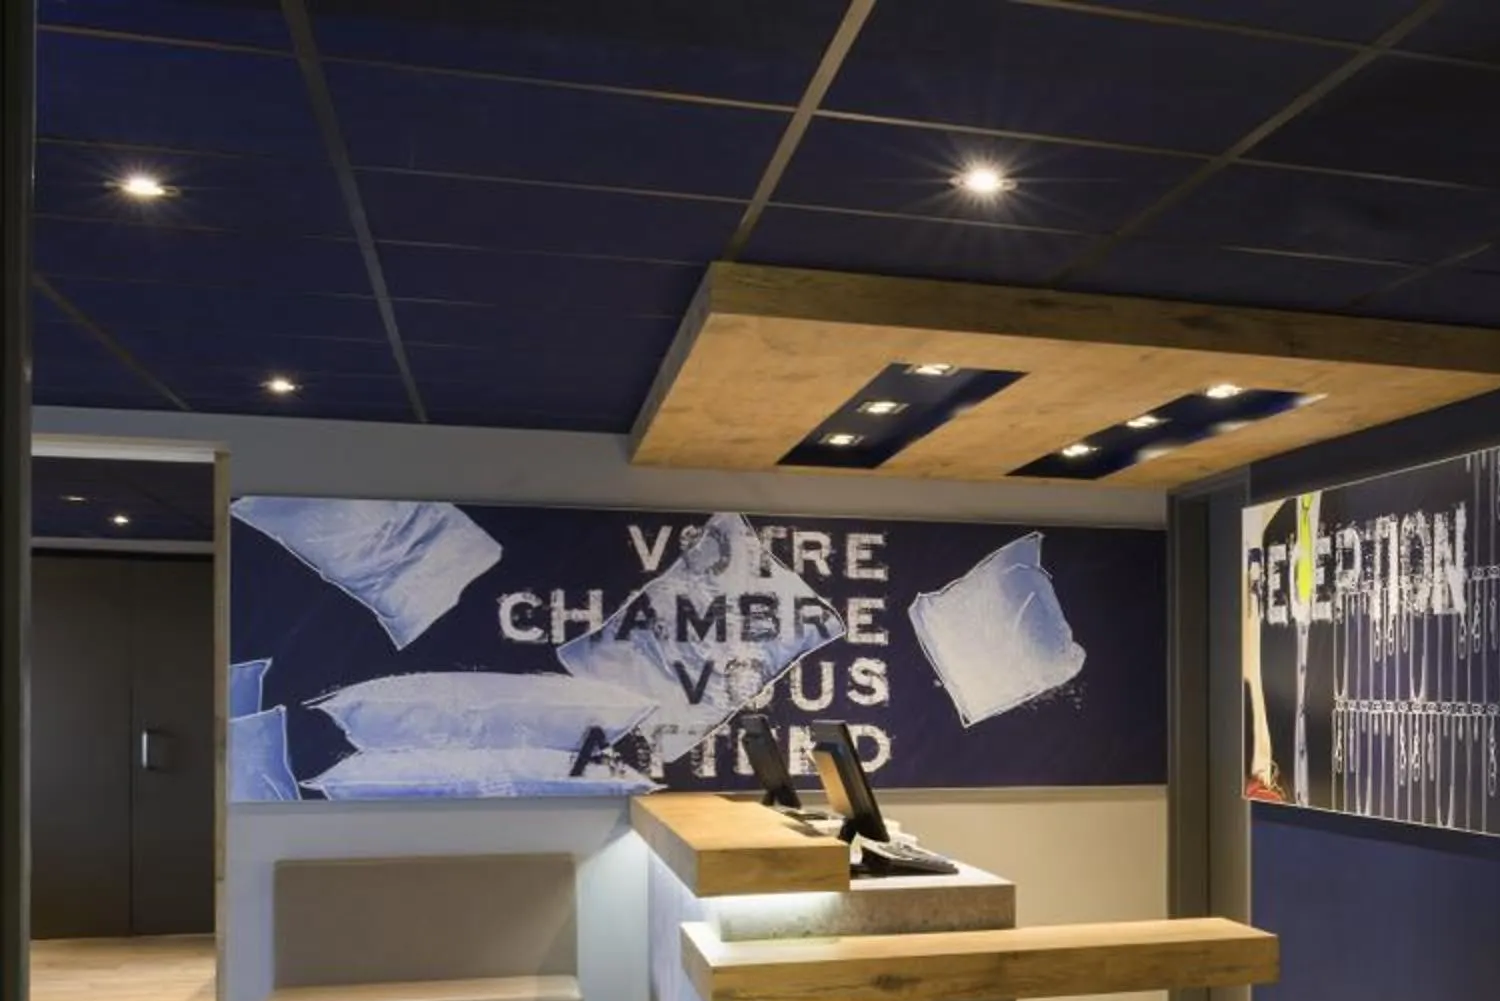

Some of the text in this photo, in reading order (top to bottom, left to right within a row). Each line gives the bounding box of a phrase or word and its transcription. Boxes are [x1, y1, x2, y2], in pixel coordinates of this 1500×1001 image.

[628, 523, 889, 581] VOTRE
[498, 588, 890, 646] CHAMBRE
[673, 656, 891, 712] VOUS
